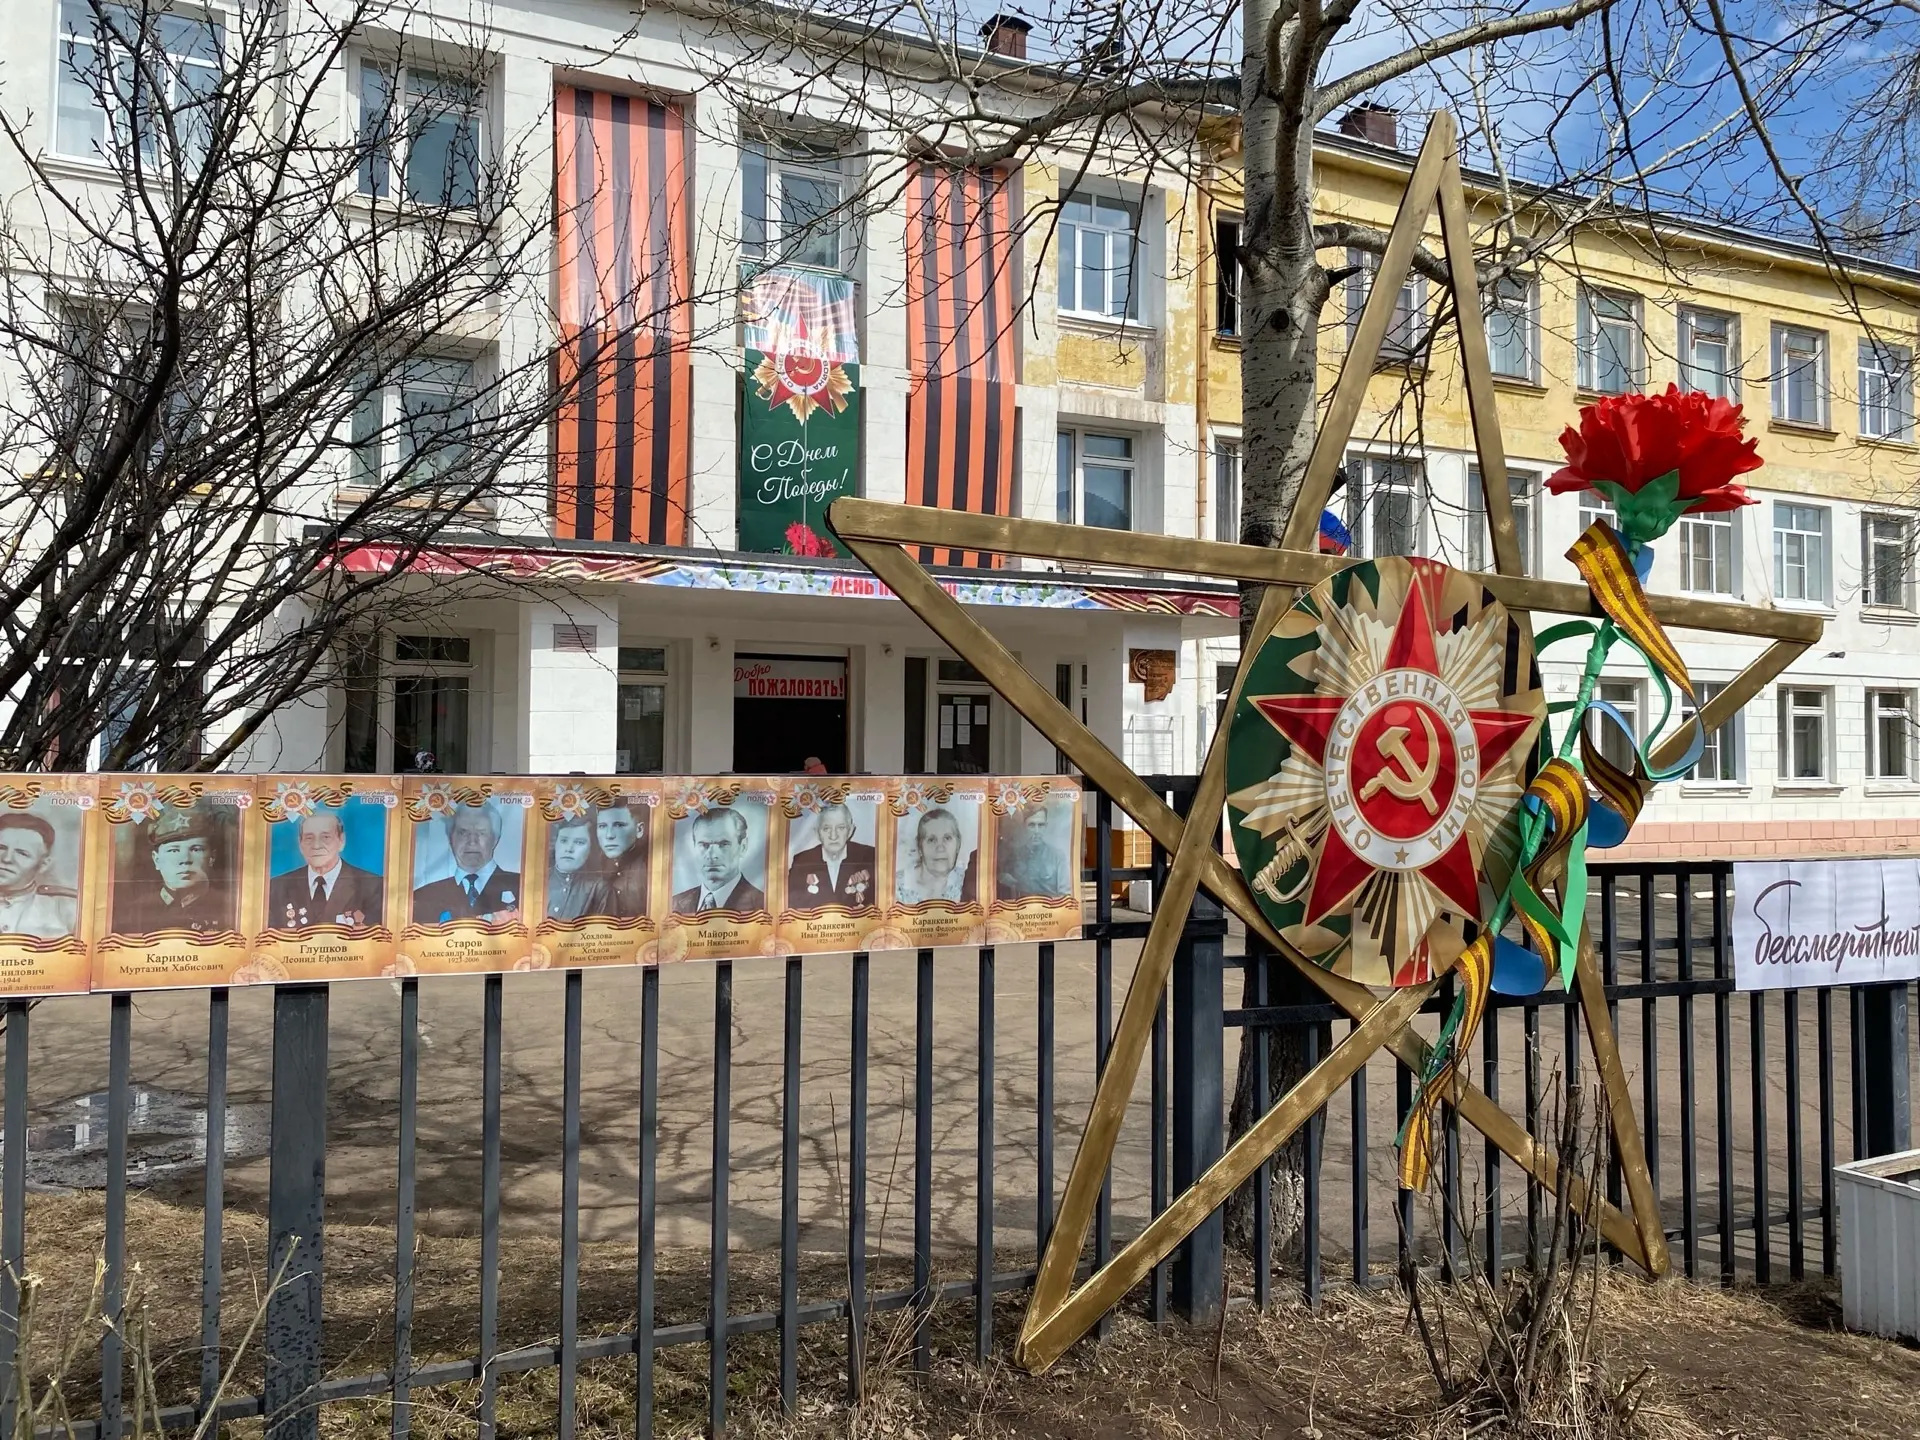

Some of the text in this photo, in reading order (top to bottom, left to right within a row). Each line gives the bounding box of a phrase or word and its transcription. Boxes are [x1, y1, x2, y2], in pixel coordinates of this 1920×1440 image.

[751, 438, 839, 473] С Днем
[756, 468, 848, 505] Победы!
[831, 576, 875, 596] ДЕНЬ
[734, 663, 771, 682] Добро
[748, 677, 844, 698] пожаловать!
[1327, 673, 1476, 852] ОТЕЧЕСТВЕННАЯ ВОЙНА
[806, 922, 856, 932] Каранкевич
[912, 917, 959, 926] Каранкевич
[580, 933, 612, 941] Хохлова
[698, 930, 739, 939] Майоров
[820, 931, 860, 939] Викторович
[300, 944, 348, 955] Глушков
[446, 939, 482, 949] Старов
[687, 940, 705, 948] Иван
[146, 953, 199, 964] Каримов
[281, 954, 364, 965] Леонид Ефимович
[420, 949, 507, 959] Александр Иванович
[120, 963, 224, 975] Муртазим Хабисович
